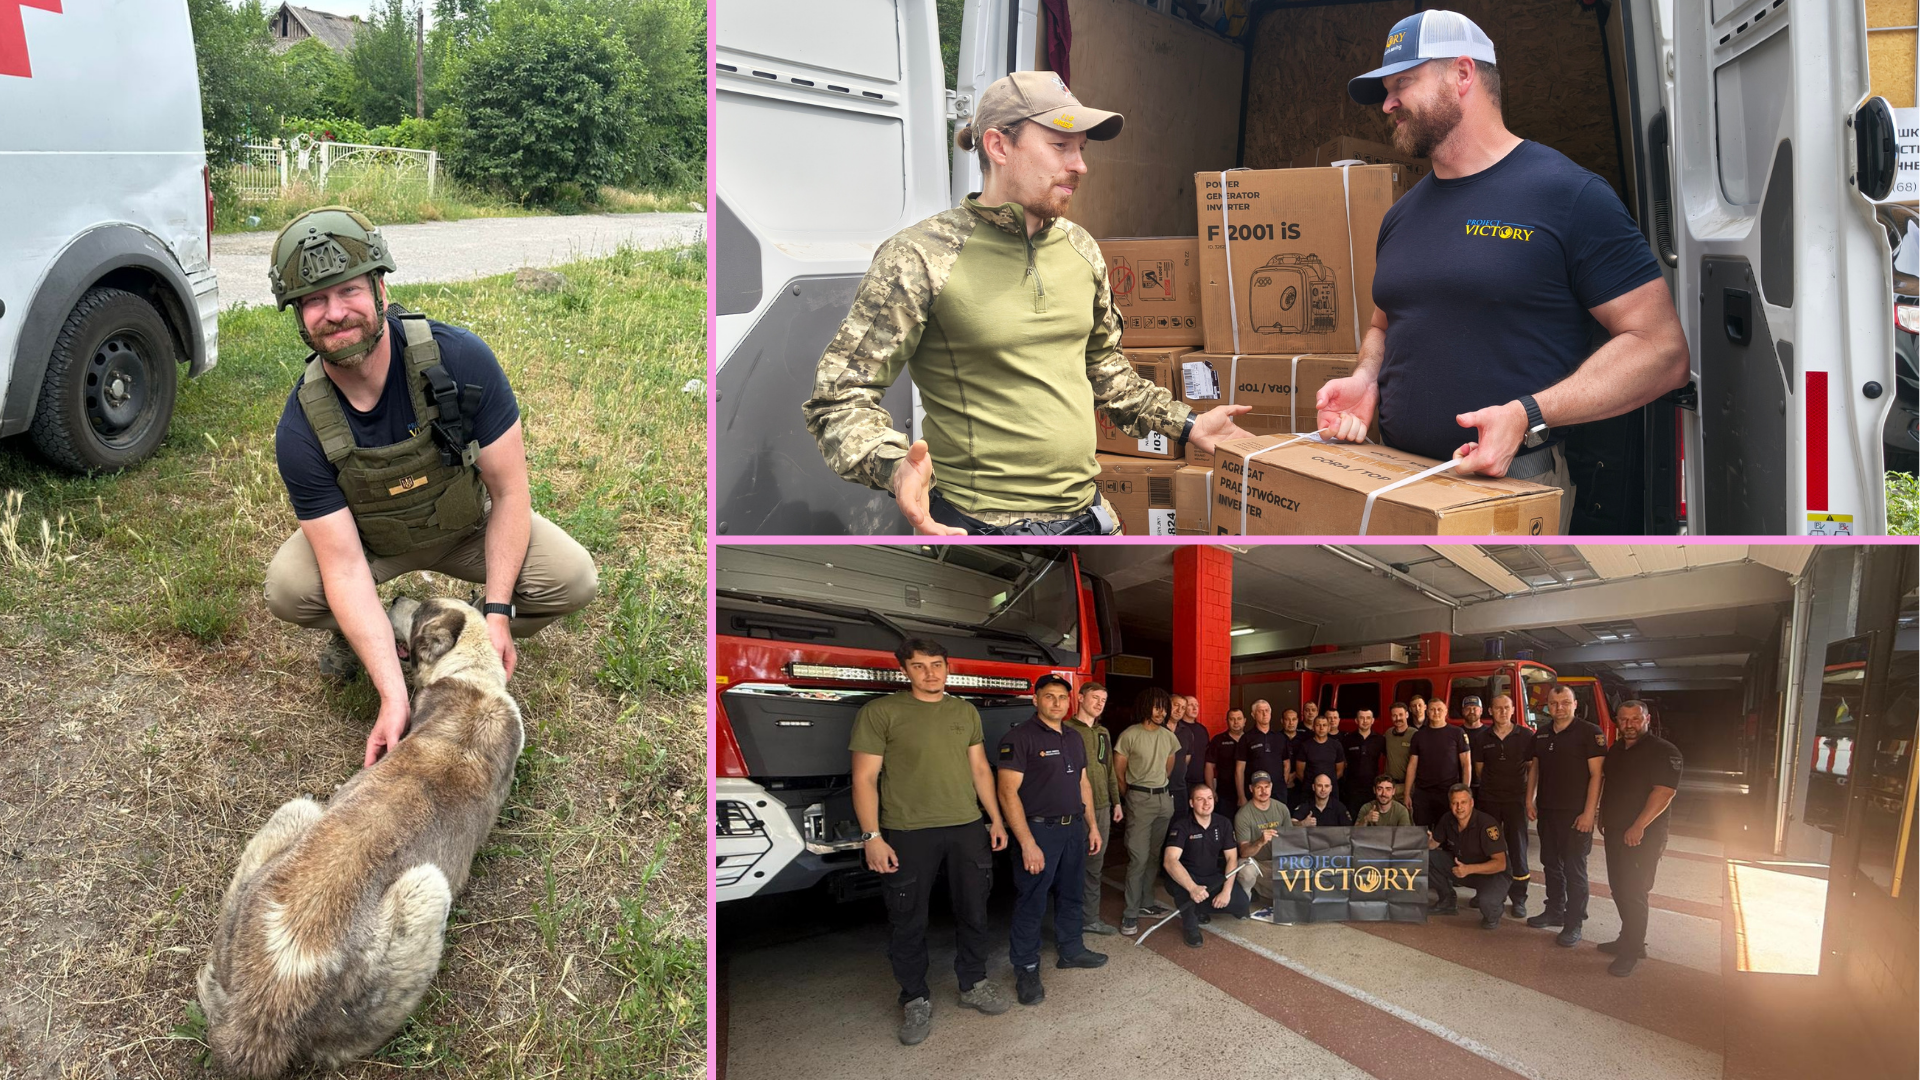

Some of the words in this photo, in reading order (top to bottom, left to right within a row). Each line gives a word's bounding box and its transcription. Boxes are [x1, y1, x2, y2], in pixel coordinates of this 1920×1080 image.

[1899, 128, 1919, 138] ШК
[1900, 145, 1919, 154] СТ
[1205, 180, 1239, 189] POWER
[1206, 191, 1260, 201] GENERATOR
[1206, 203, 1250, 211] INVRTER
[1466, 219, 1502, 227] PROJECT
[1207, 225, 1220, 241] F
[1228, 223, 1274, 241] 2001
[1281, 221, 1301, 240] iS
[1465, 224, 1535, 242] VICTORY
[1238, 383, 1260, 393] TOP
[409, 427, 421, 438] VI
[1153, 432, 1161, 451] 103
[1221, 460, 1264, 482] AGREGAT
[1360, 470, 1391, 481] TOP
[1220, 476, 1300, 512] PRĄDOTWÓRCZY
[1166, 512, 1176, 536] 824
[1278, 855, 1354, 871] PROJECT
[1277, 865, 1422, 894] VICTORY
